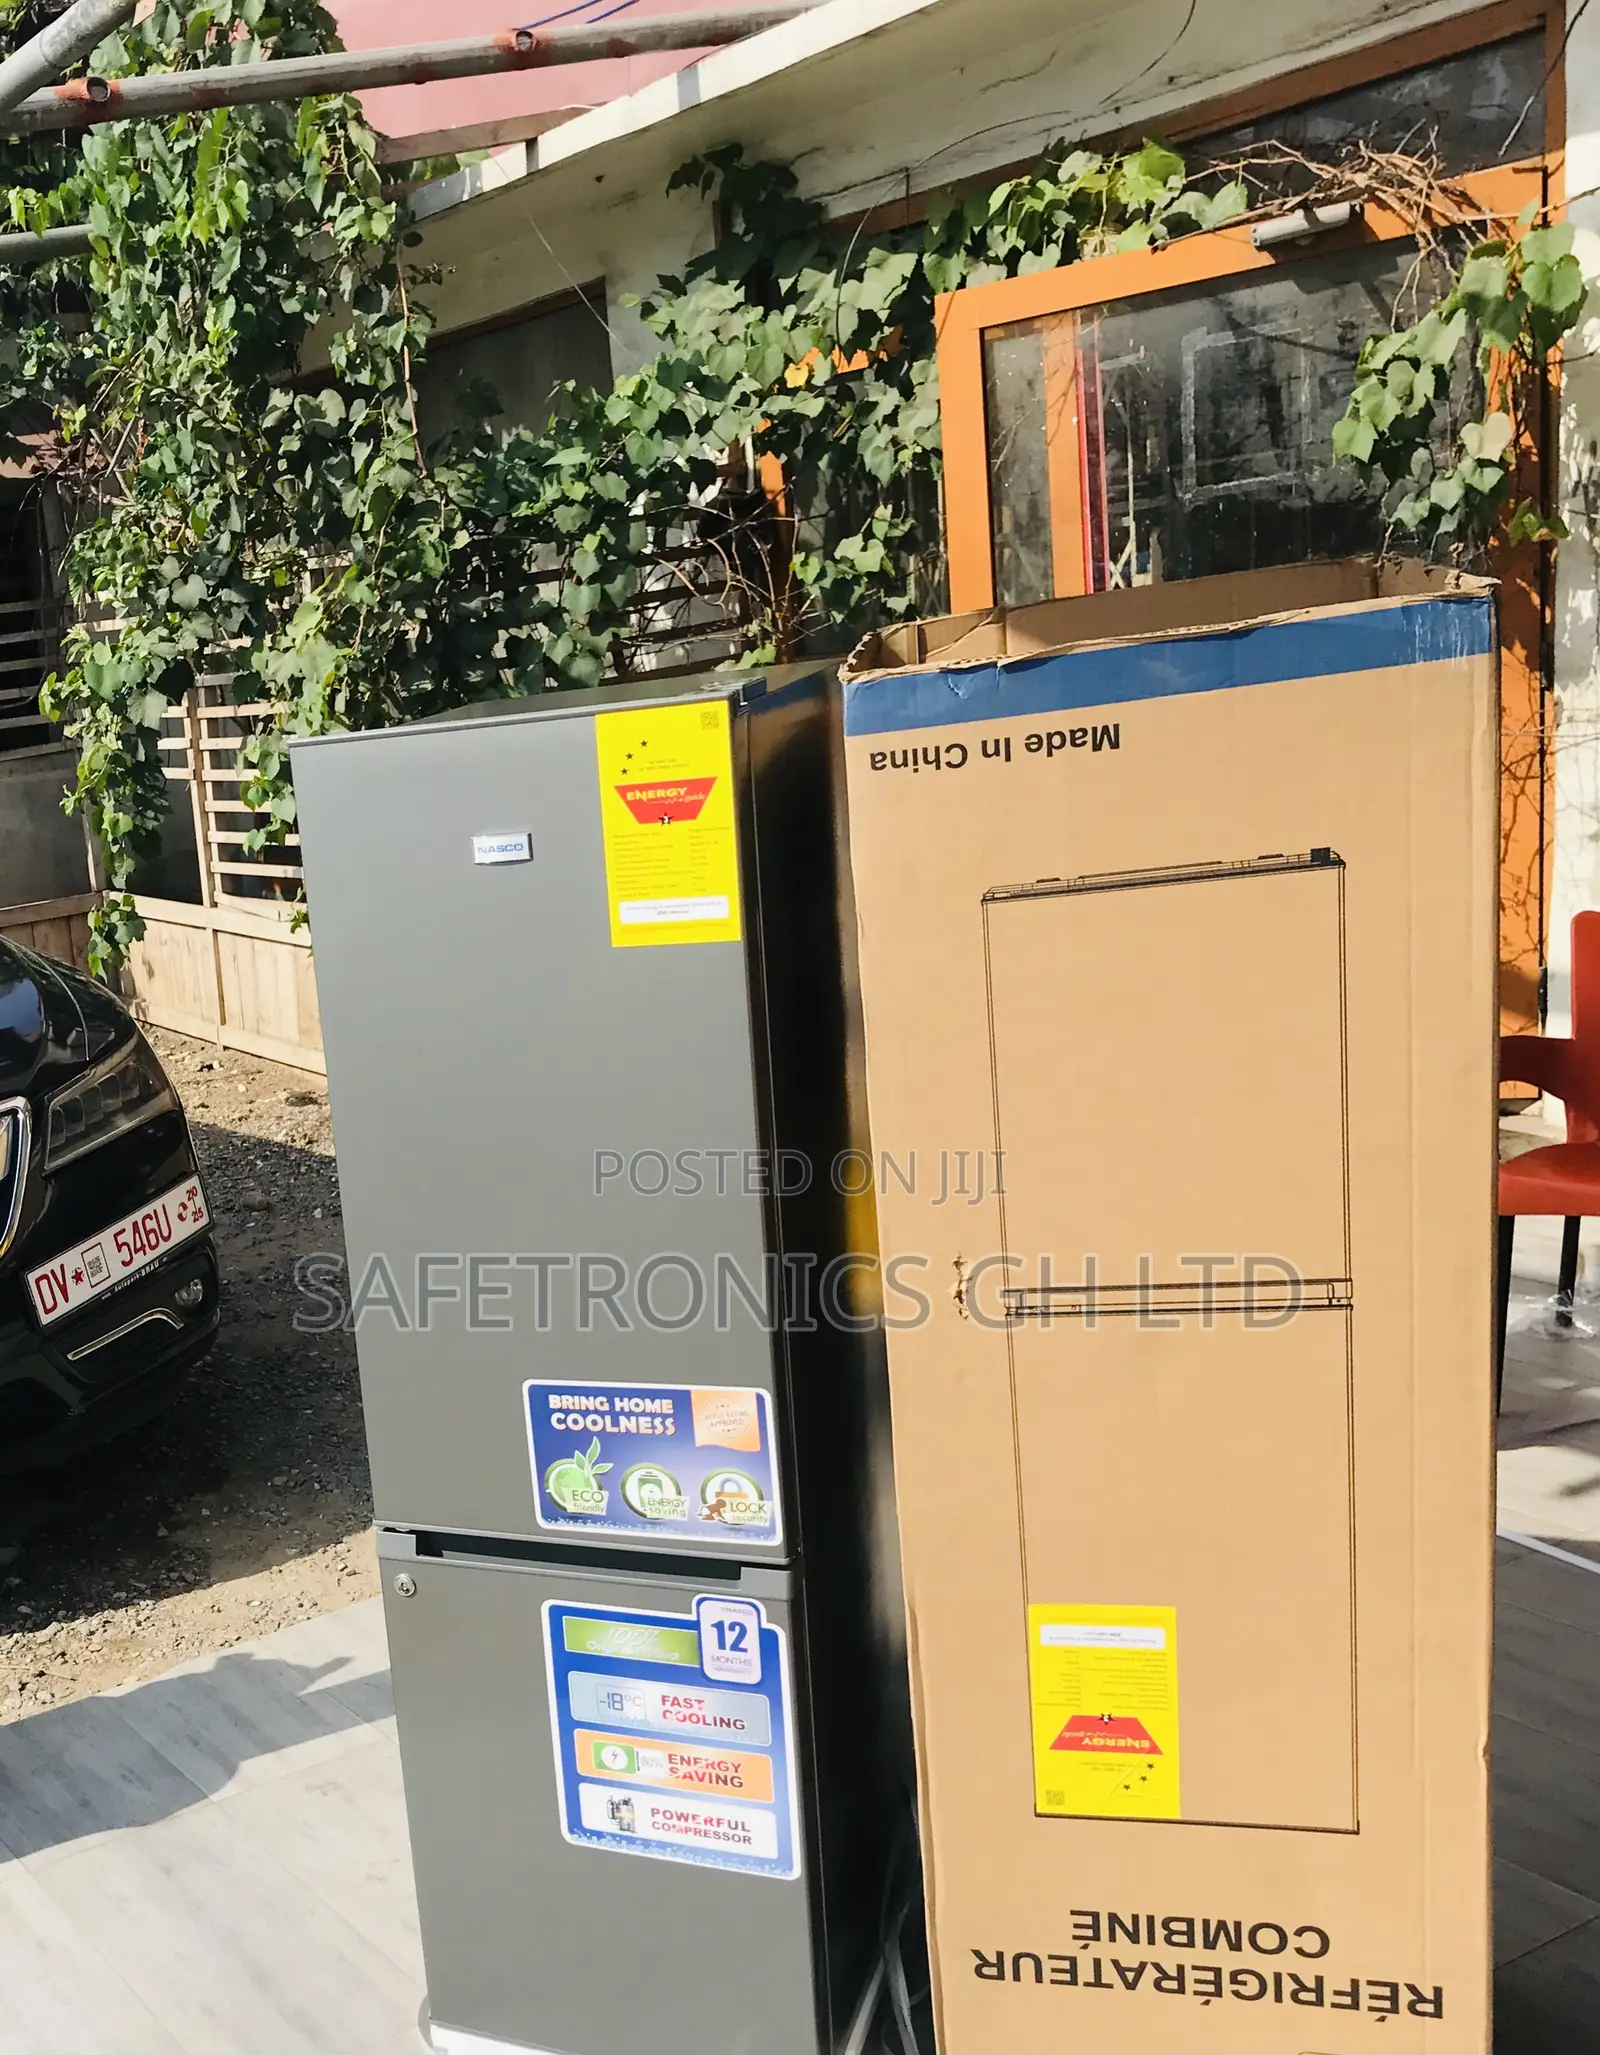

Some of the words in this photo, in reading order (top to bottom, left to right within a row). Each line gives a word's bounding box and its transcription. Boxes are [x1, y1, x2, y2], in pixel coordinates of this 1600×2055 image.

[981, 737, 1012, 763] In
[1024, 723, 1121, 758] Made
[869, 743, 968, 773] China
[625, 786, 689, 803] ENERGY
[477, 843, 524, 854] NASCO
[34, 1263, 70, 1316] DV
[113, 1203, 173, 1268] 546U
[548, 1394, 610, 1412] BRING
[613, 1397, 674, 1414] HOME
[550, 1412, 676, 1436] COOLNESS
[571, 1490, 604, 1503] ECO
[647, 1498, 688, 1510] ENERGY
[573, 1502, 605, 1514] friendly
[649, 1508, 687, 1519] saving
[730, 1502, 766, 1514] LOCK
[710, 1620, 748, 1653] 12
[711, 1655, 753, 1667] MONTHS
[660, 1694, 705, 1710] FAST
[662, 1710, 746, 1731] COOLING
[1082, 1737, 1150, 1749] ENERGY
[667, 1753, 743, 1773] ENERGY
[668, 1766, 744, 1788] SAVING
[650, 1807, 752, 1832] POWERFUL
[651, 1821, 753, 1845] COMPRESSOR
[1069, 1909, 1331, 1959] COMBINÉ
[970, 1948, 1444, 2022] RÉFRIGÉRATEUR
